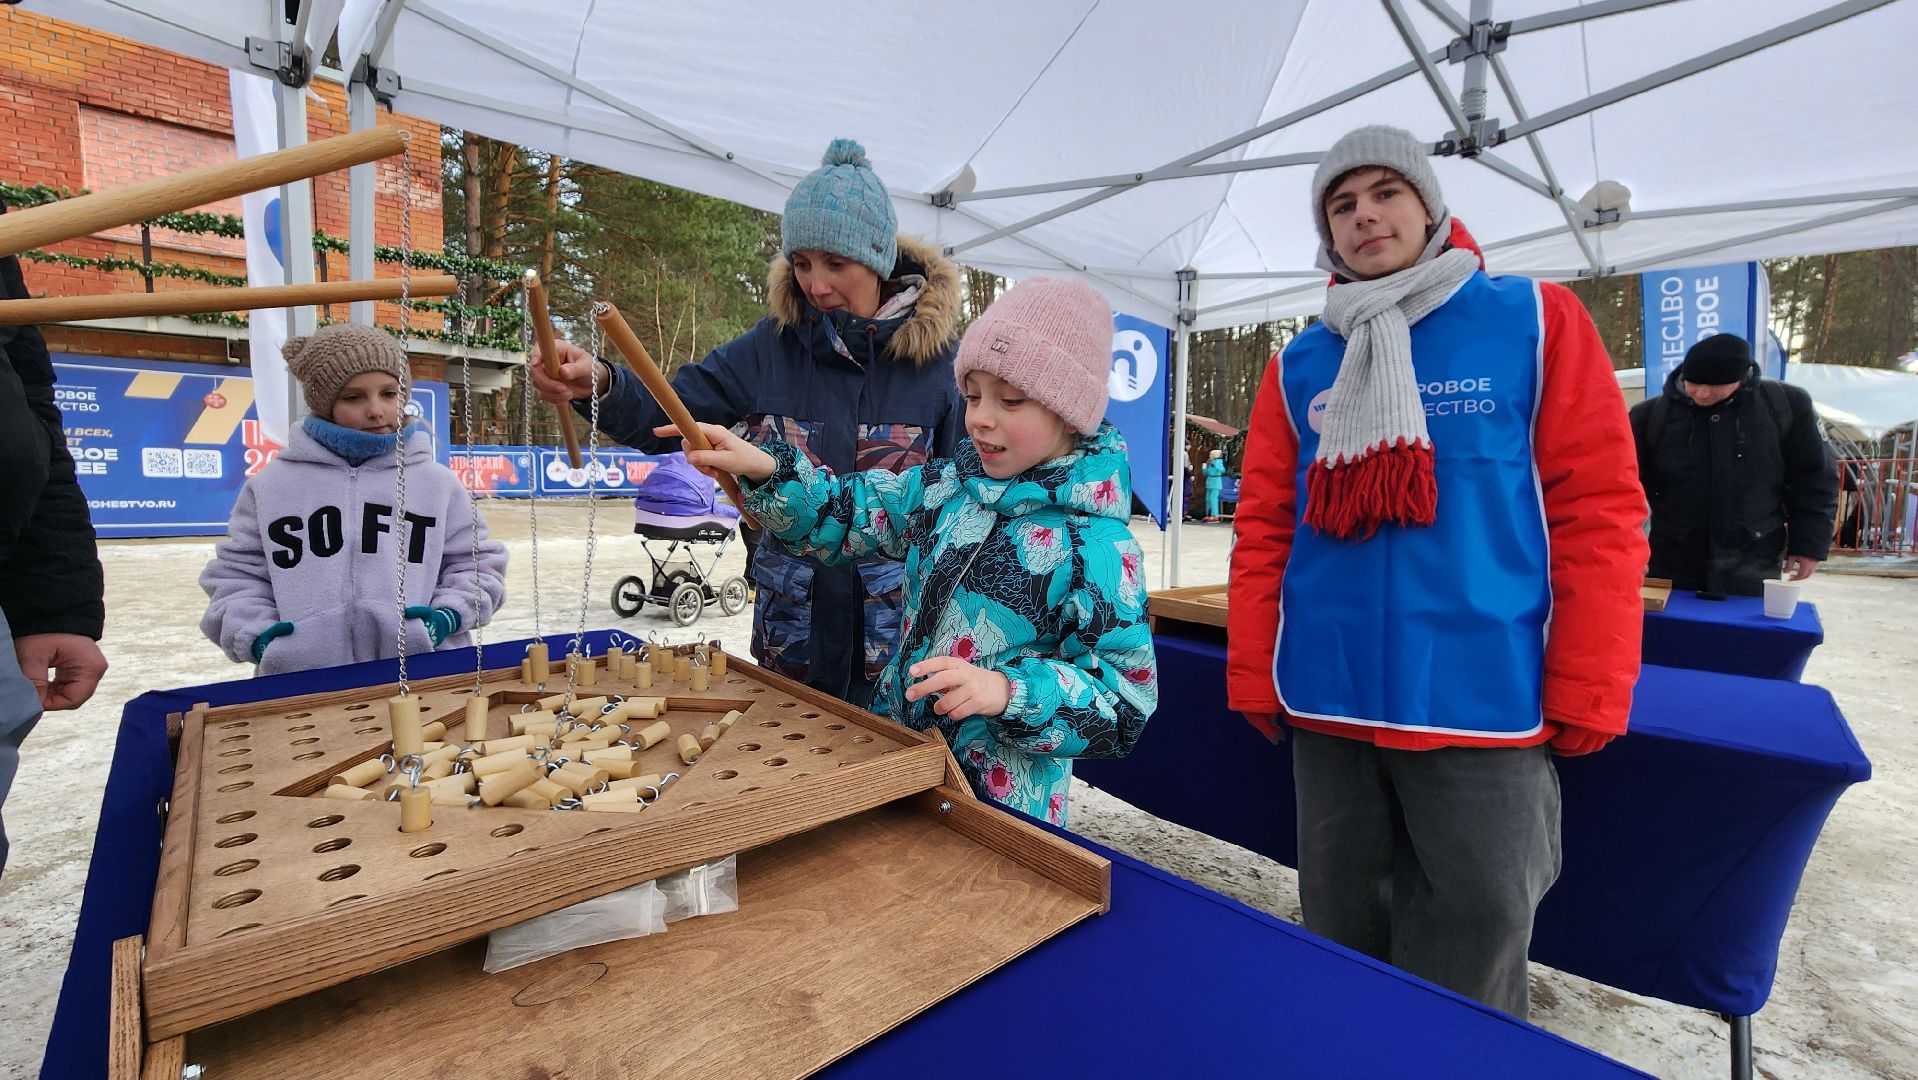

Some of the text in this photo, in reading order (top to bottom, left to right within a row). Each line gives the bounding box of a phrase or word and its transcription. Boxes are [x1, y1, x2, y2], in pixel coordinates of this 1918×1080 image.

[1423, 398, 1496, 417] ЕСТВО
[74, 461, 108, 475] ЕЕ
[268, 502, 436, 569] SOFT
